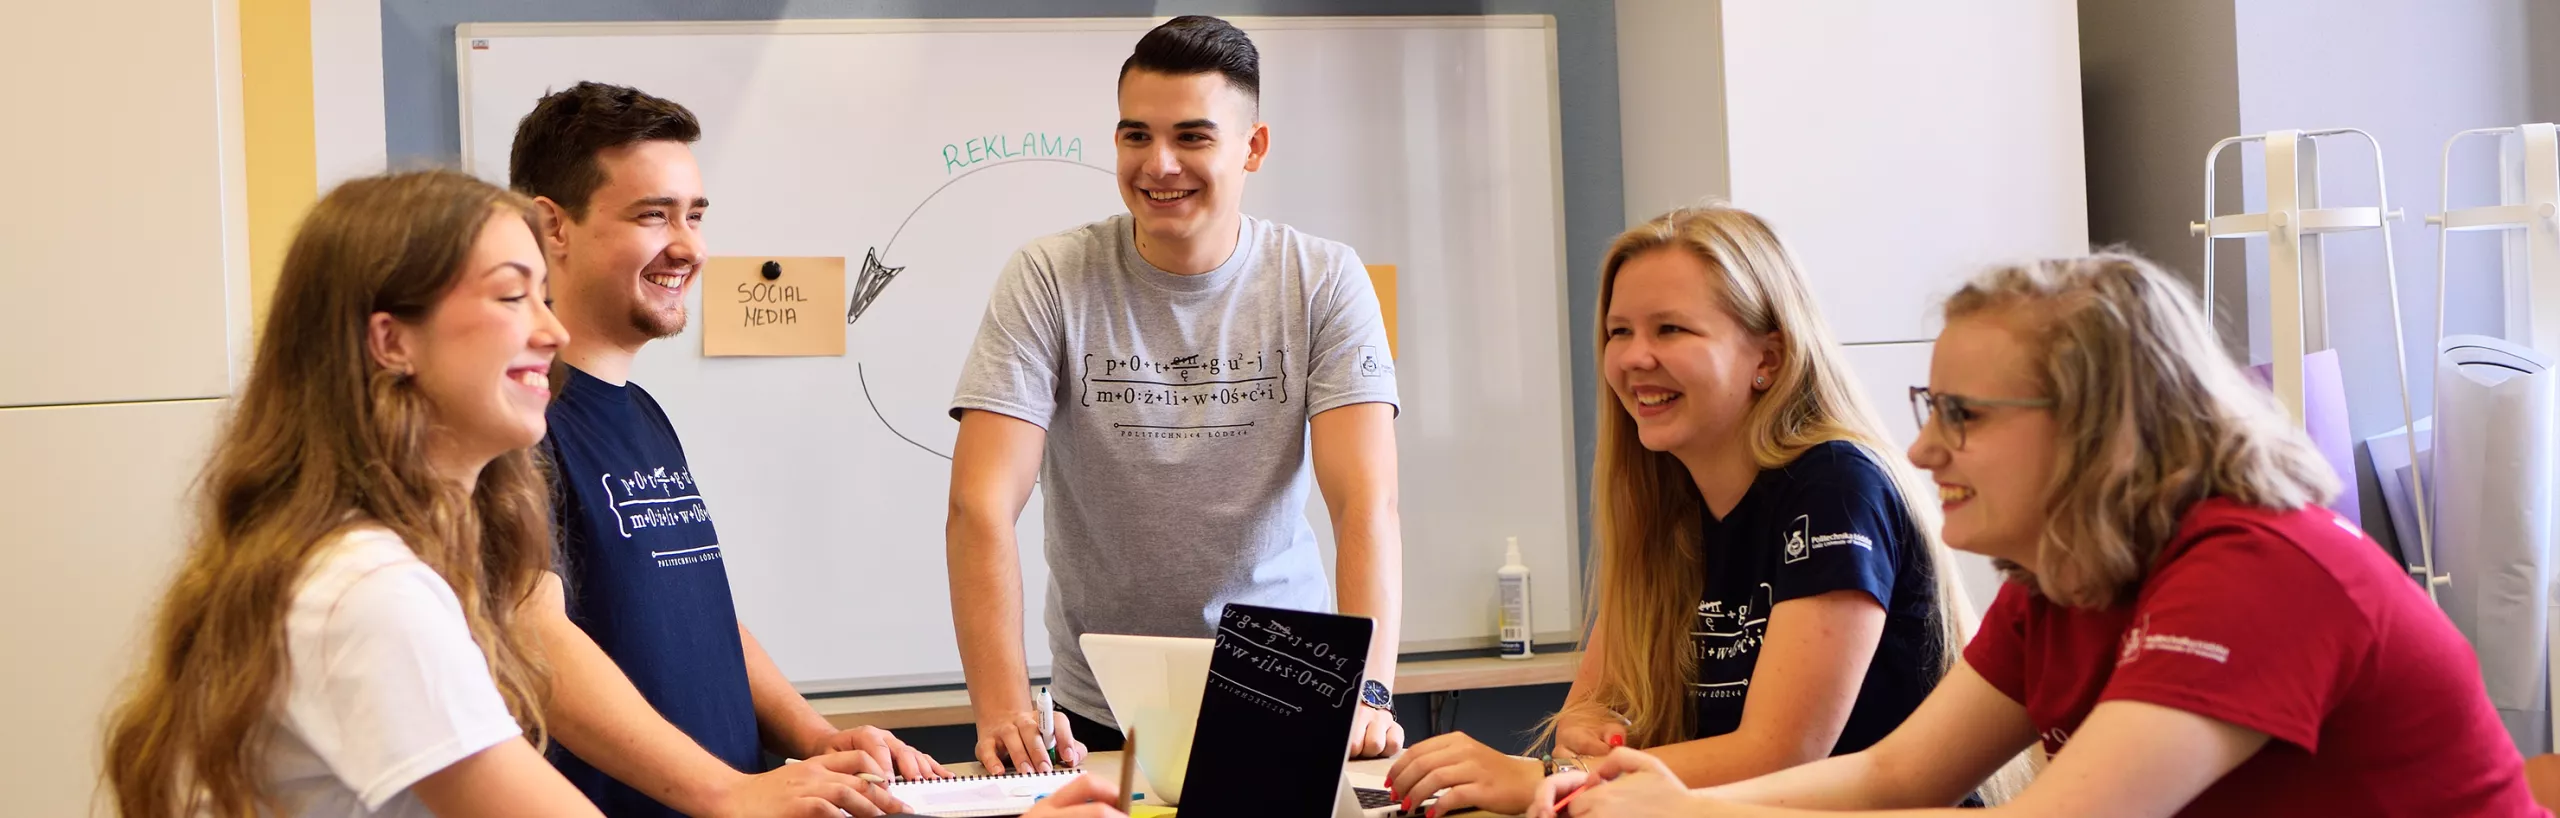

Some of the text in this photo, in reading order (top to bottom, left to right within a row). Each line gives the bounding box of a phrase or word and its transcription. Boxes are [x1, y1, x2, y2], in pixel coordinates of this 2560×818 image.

[943, 132, 1082, 174] REKLAMA
[737, 282, 808, 304] SOCIAL
[743, 305, 797, 328] MEDIA
